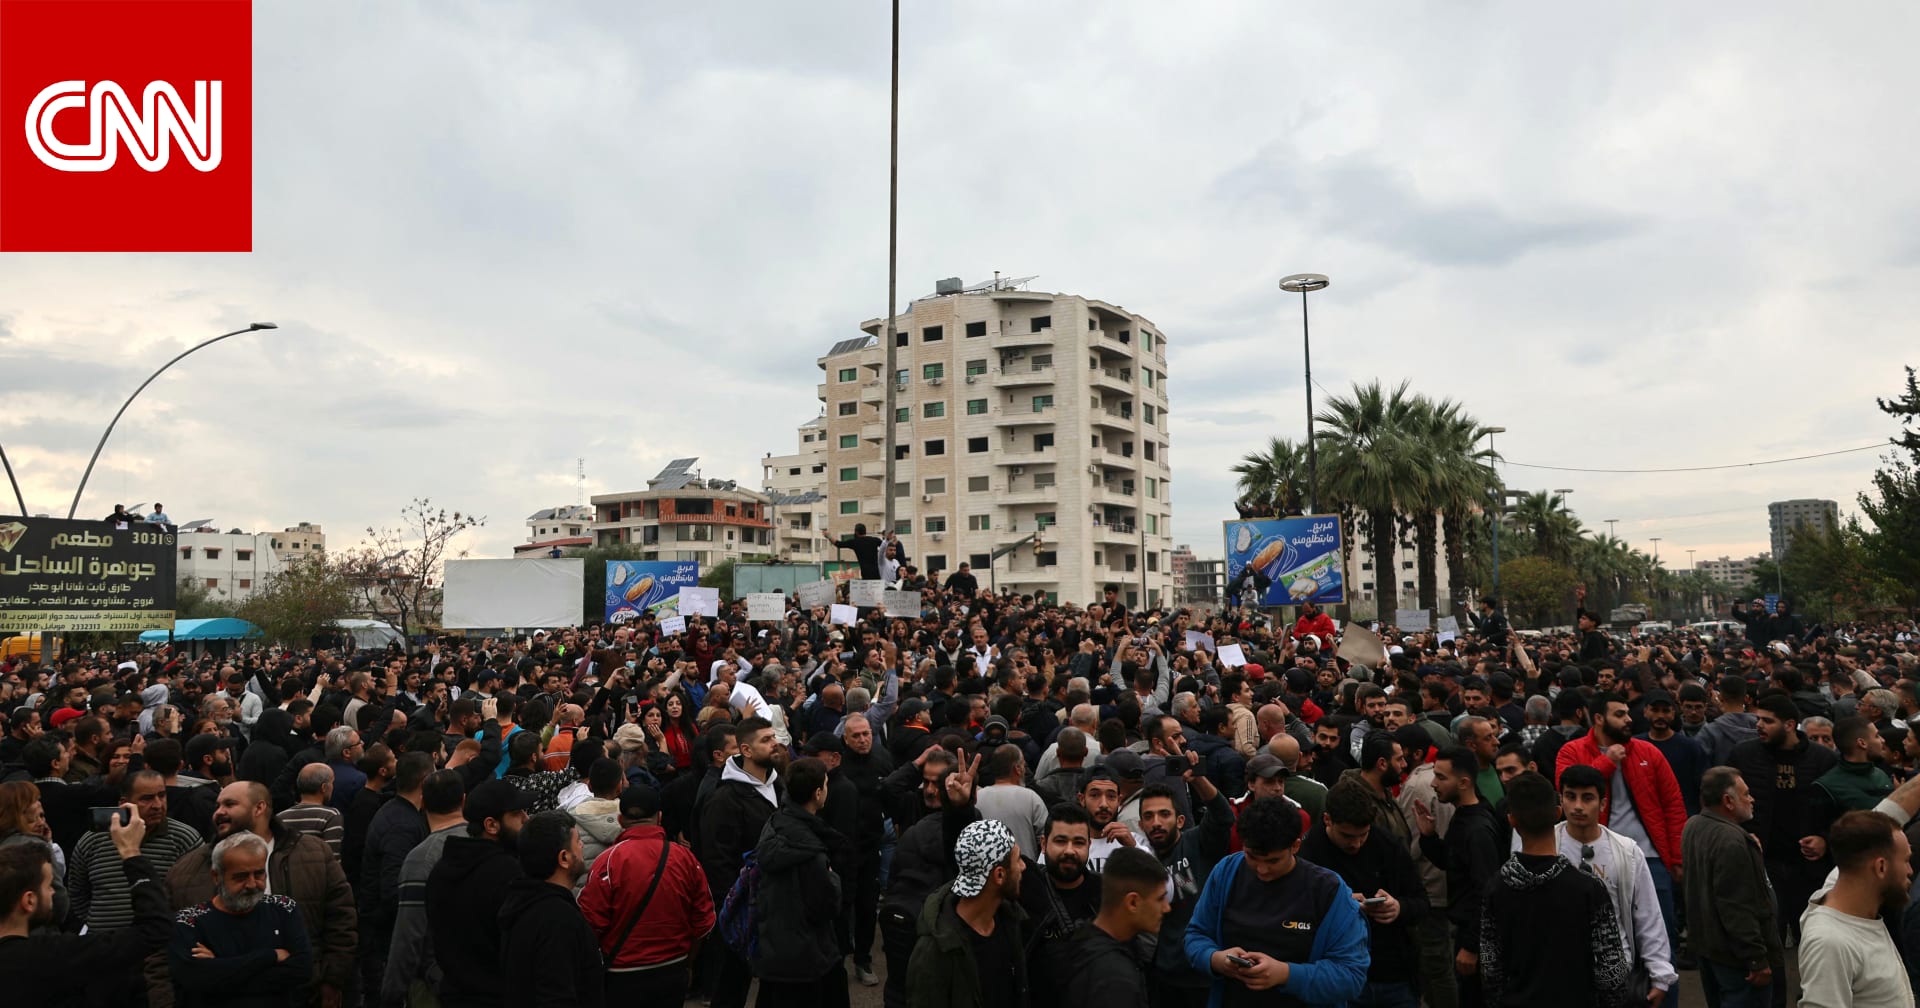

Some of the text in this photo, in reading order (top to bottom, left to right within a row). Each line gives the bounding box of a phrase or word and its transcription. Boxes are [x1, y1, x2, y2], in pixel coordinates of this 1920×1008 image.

[51, 530, 114, 549] مطعم
[132, 531, 163, 544] 3031
[0, 554, 156, 581] جوهرة الساحل
[28, 581, 49, 592] صخر
[50, 580, 64, 593] أبو
[108, 583, 131, 593] طارق
[38, 596, 68, 606] الفحم
[69, 596, 90, 605] على
[91, 595, 126, 607] مشاوي
[132, 597, 154, 608] فروج
[1297, 921, 1311, 930] GLS
